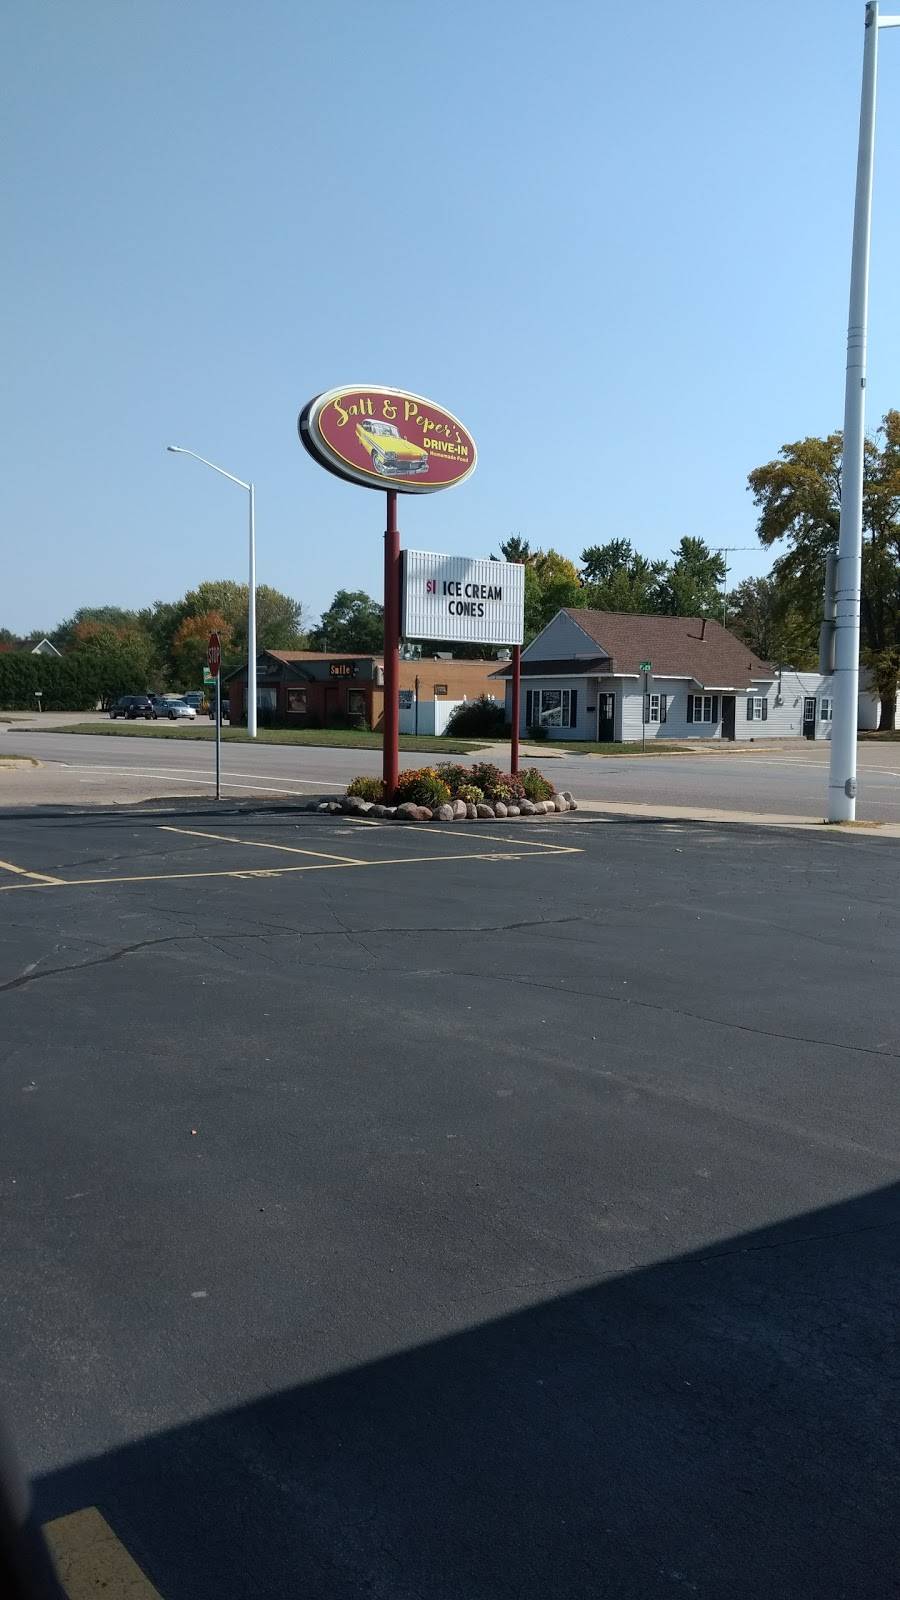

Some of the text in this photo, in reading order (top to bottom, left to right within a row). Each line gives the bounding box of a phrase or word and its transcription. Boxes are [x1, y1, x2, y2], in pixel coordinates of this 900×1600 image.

[333, 398, 462, 443] Salt & Peper's
[423, 437, 468, 456] DRIVE-IN
[429, 450, 469, 463] Homemade Food
[443, 581, 462, 597] ICE
[464, 583, 502, 601] CREAM
[448, 600, 484, 617] CONES
[208, 647, 220, 664] STOP
